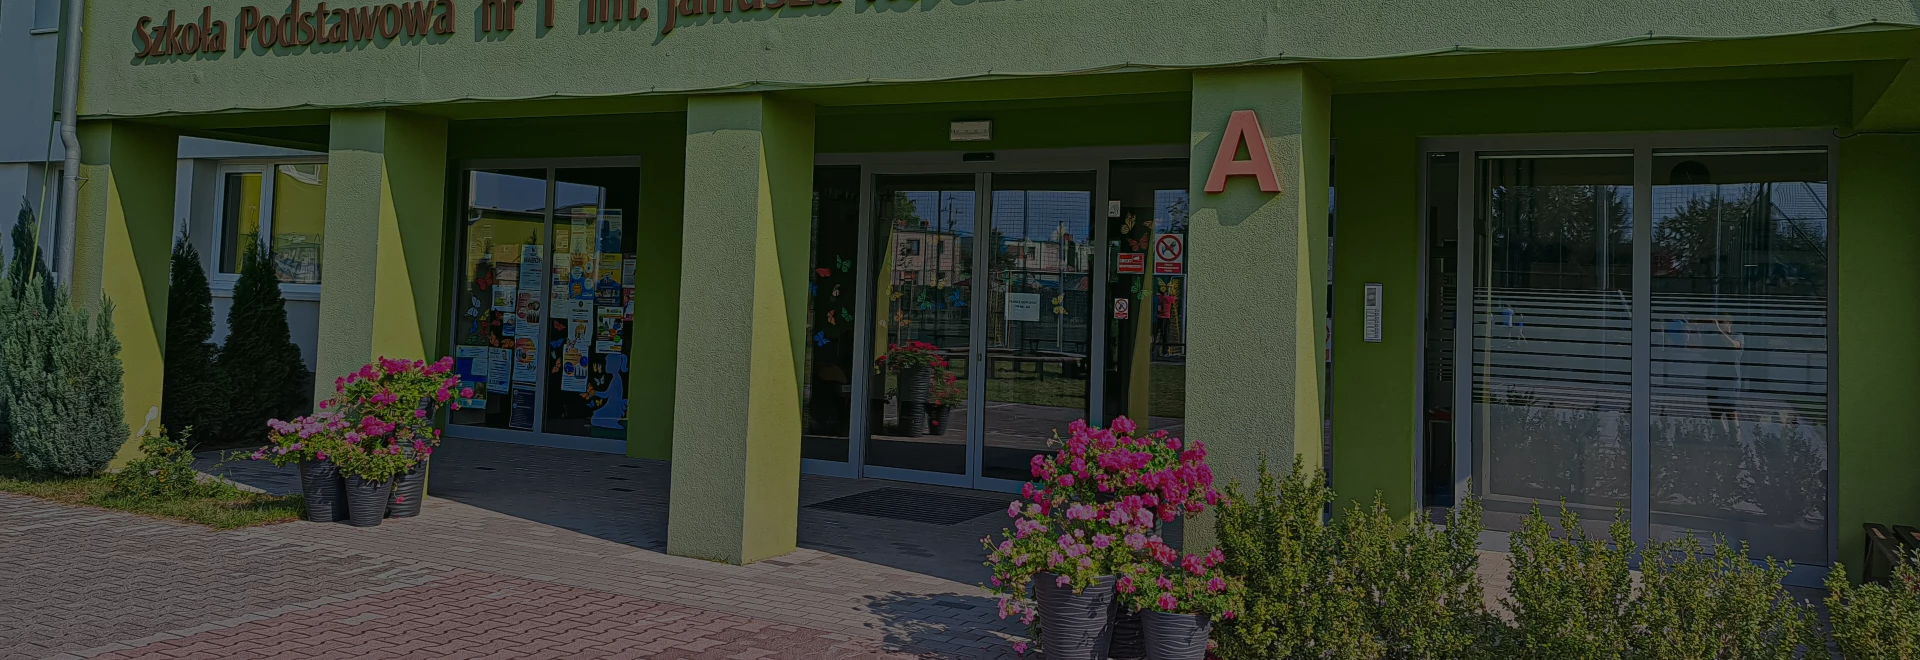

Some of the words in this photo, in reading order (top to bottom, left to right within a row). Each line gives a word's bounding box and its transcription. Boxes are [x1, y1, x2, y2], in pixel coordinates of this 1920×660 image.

[135, 6, 227, 58] Szkoła
[239, 0, 456, 49] Podstawowa
[1204, 109, 1281, 193] A
